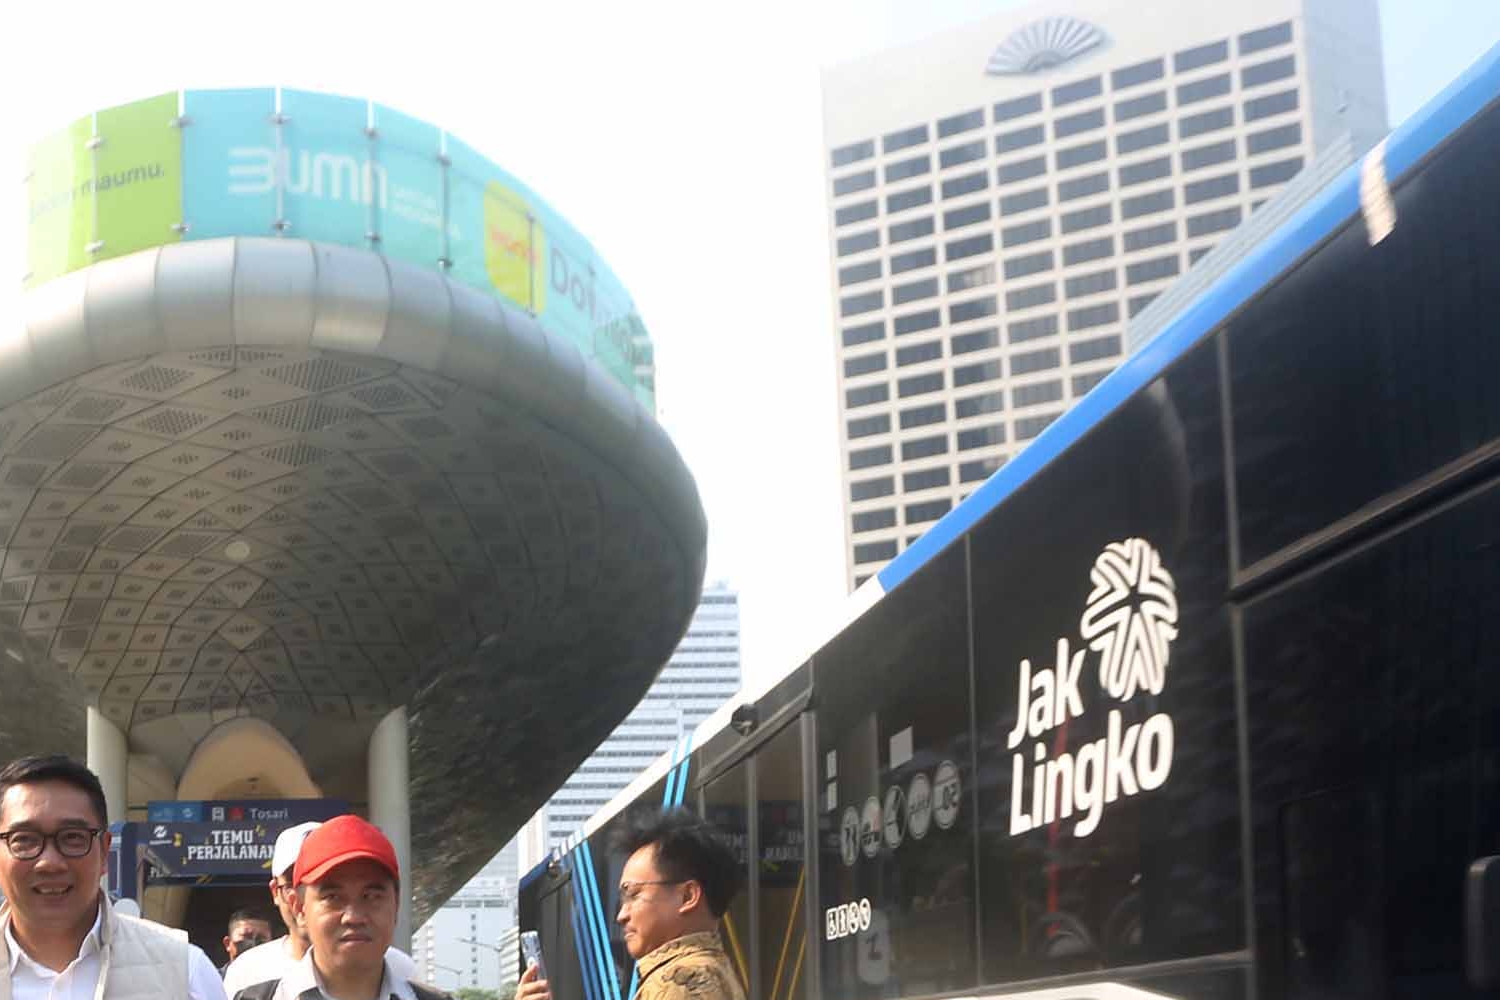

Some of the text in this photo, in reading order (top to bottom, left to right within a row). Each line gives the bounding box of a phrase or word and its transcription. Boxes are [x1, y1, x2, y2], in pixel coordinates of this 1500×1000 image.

[1008, 637, 1086, 749] Jak
[1009, 709, 1174, 837] Lingko
[211, 830, 254, 845] TEMU
[250, 807, 288, 820] Tosari
